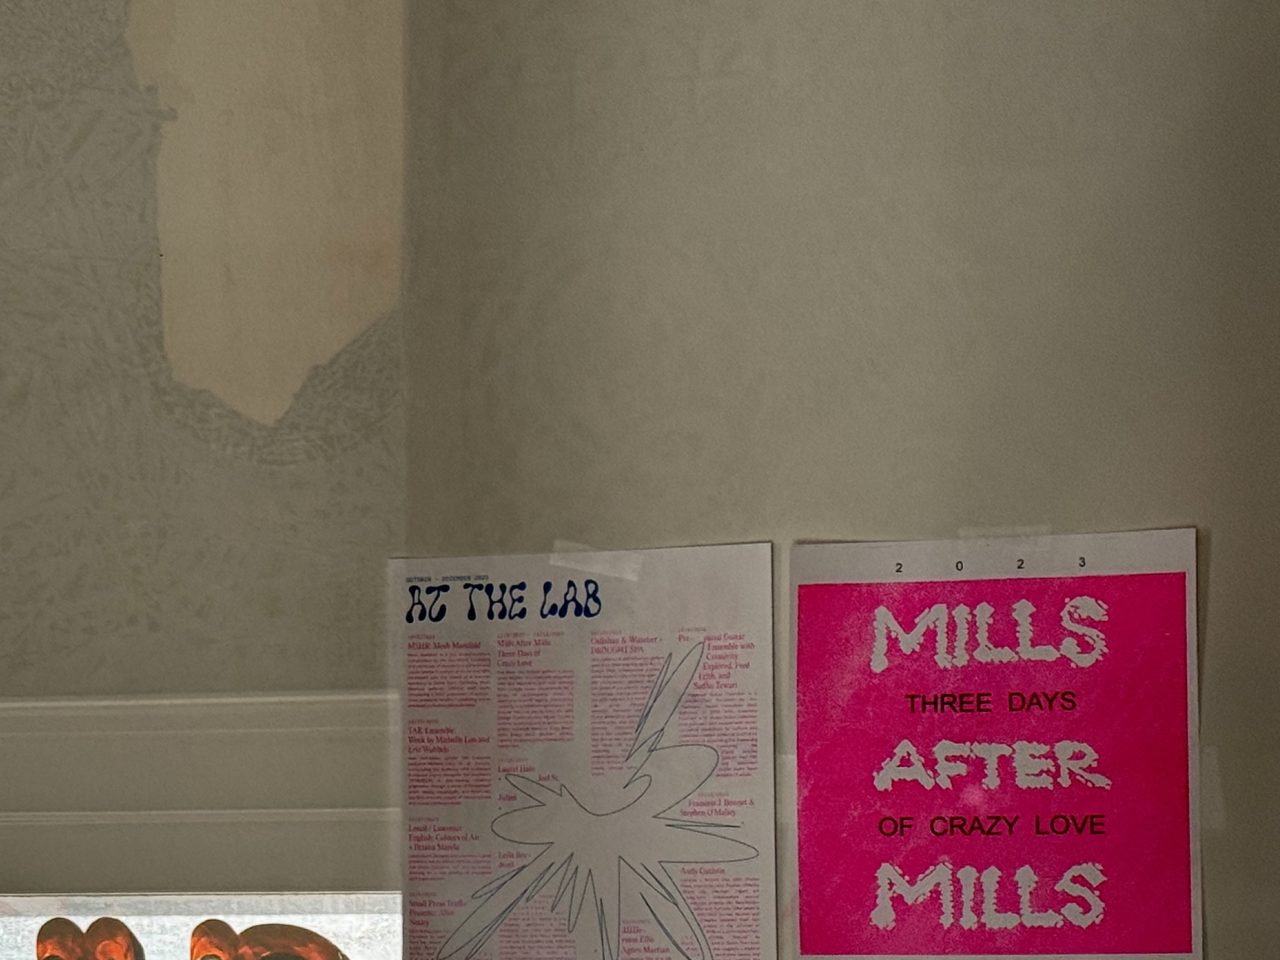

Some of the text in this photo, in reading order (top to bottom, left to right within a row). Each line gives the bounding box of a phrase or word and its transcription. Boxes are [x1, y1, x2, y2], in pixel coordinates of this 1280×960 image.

[406, 578, 602, 623] AT THE LAB
[870, 595, 1109, 673] MILLS
[906, 691, 1076, 713] THREE DAYS
[873, 739, 1111, 790] AFTER
[878, 815, 1105, 837] OF CRAZY LOVE
[870, 860, 1108, 930] MILLS
